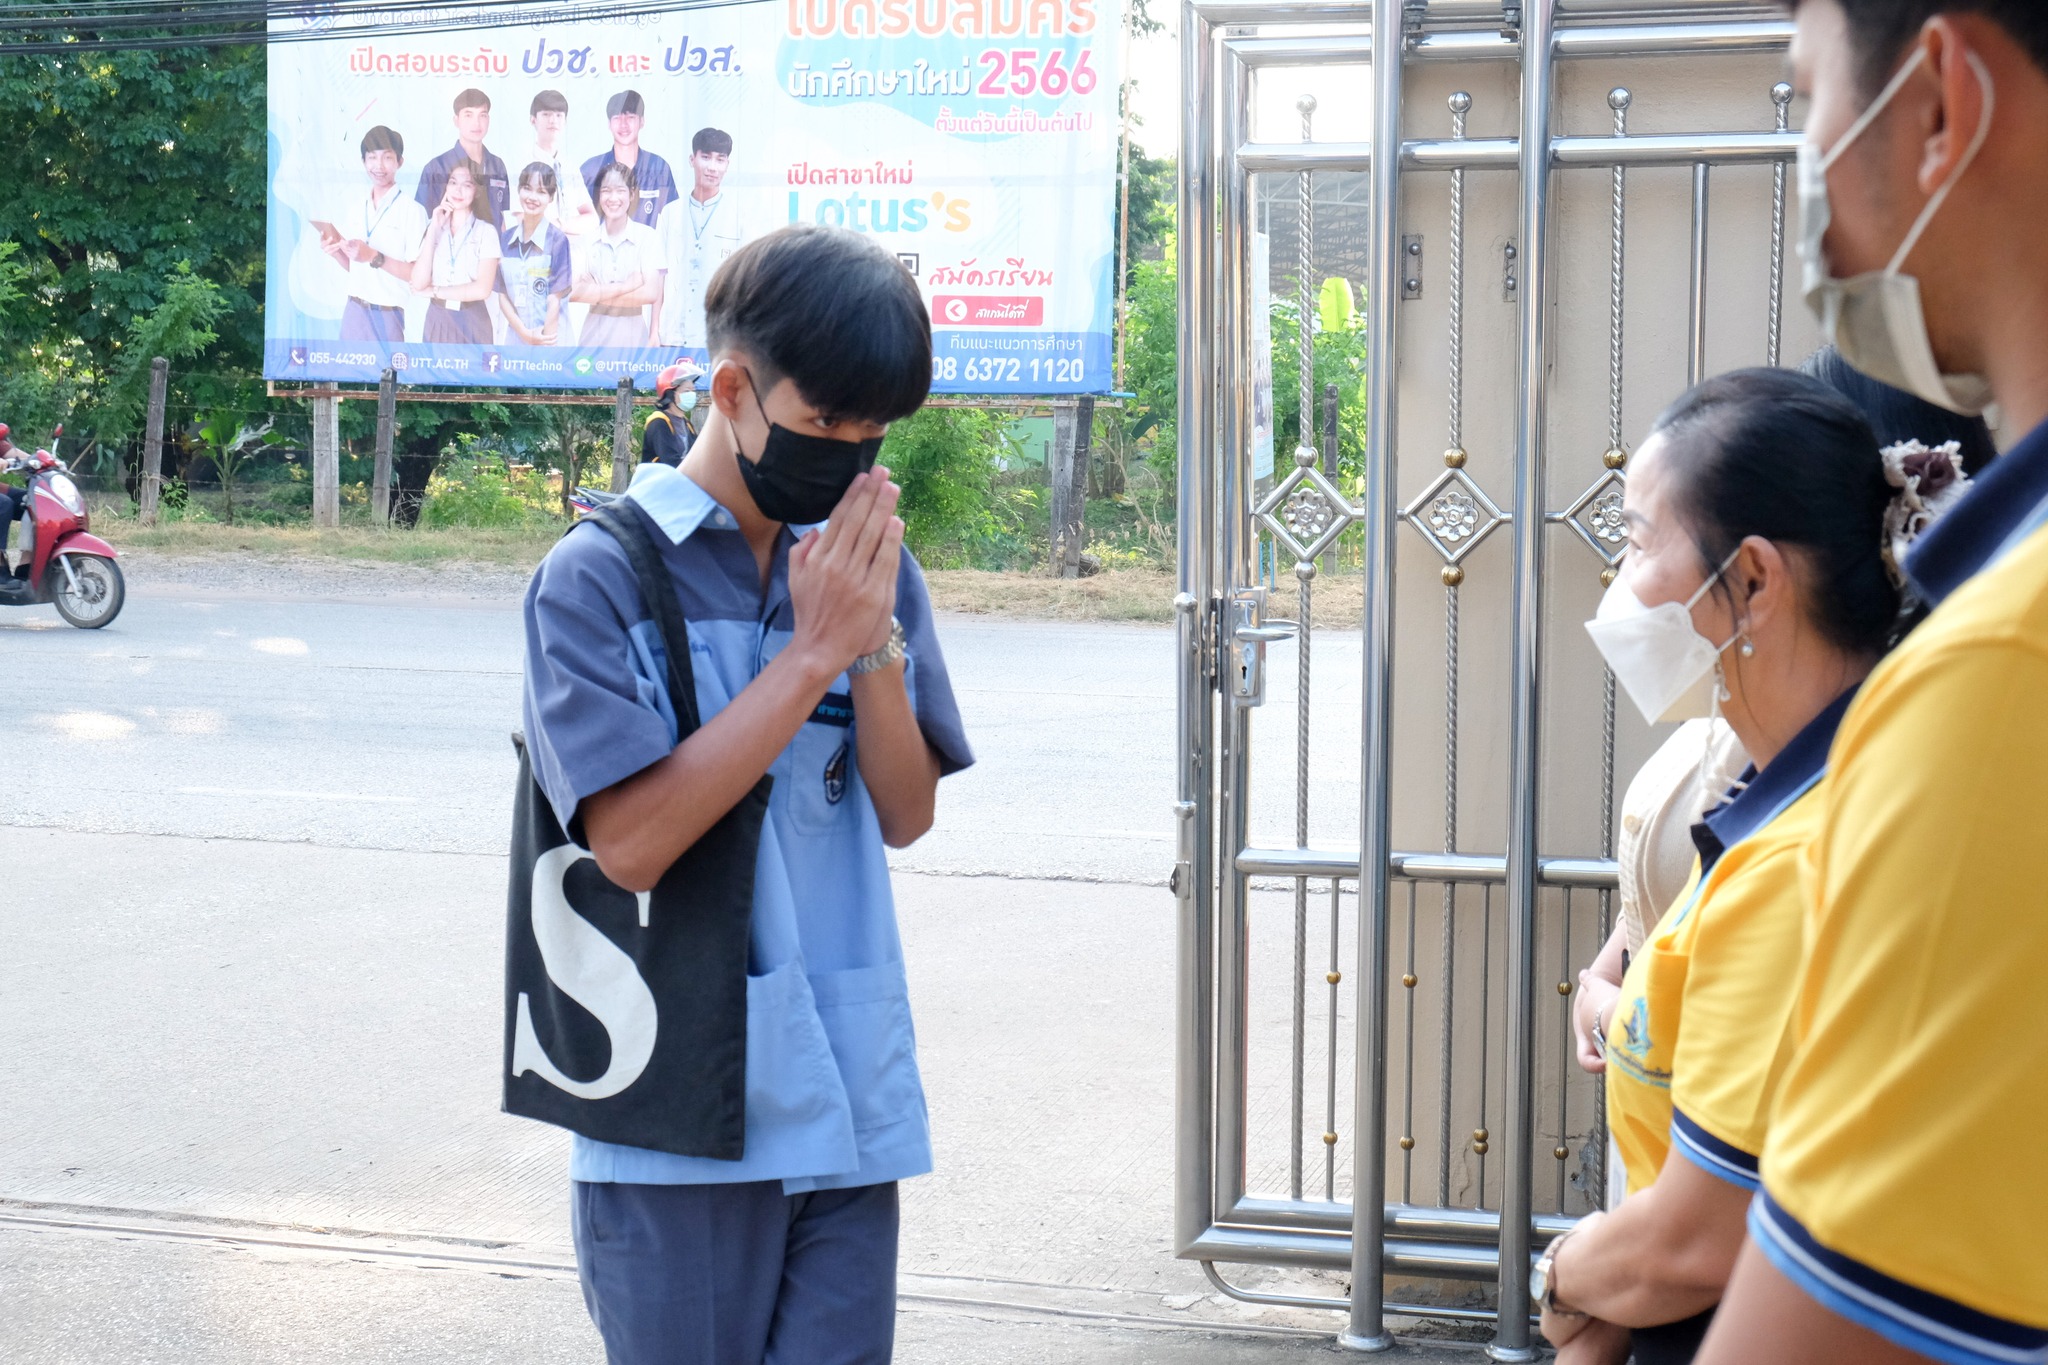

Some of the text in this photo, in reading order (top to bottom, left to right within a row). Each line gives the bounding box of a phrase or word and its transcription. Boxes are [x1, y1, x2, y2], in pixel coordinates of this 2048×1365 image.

[349, 35, 741, 75] เปิดสอนระดับ ปวช. และ ปวส.
[787, 50, 1098, 97] นักศึกษาใหม่ 2566
[935, 107, 1094, 133] ตั้งแต่วันนี้เป็นต้นไป
[786, 160, 913, 185] เปิดสาขาใหม่
[928, 257, 1054, 287] สมัครเรียน
[949, 334, 1084, 351] ทีมแนะแนวการศึกษา
[308, 351, 376, 366] 055-442930
[410, 357, 469, 370] UTT.AC.TH
[503, 359, 562, 372] UTTtechno
[932, 356, 1084, 382] 08 6372 1120
[512, 843, 658, 1100] S
